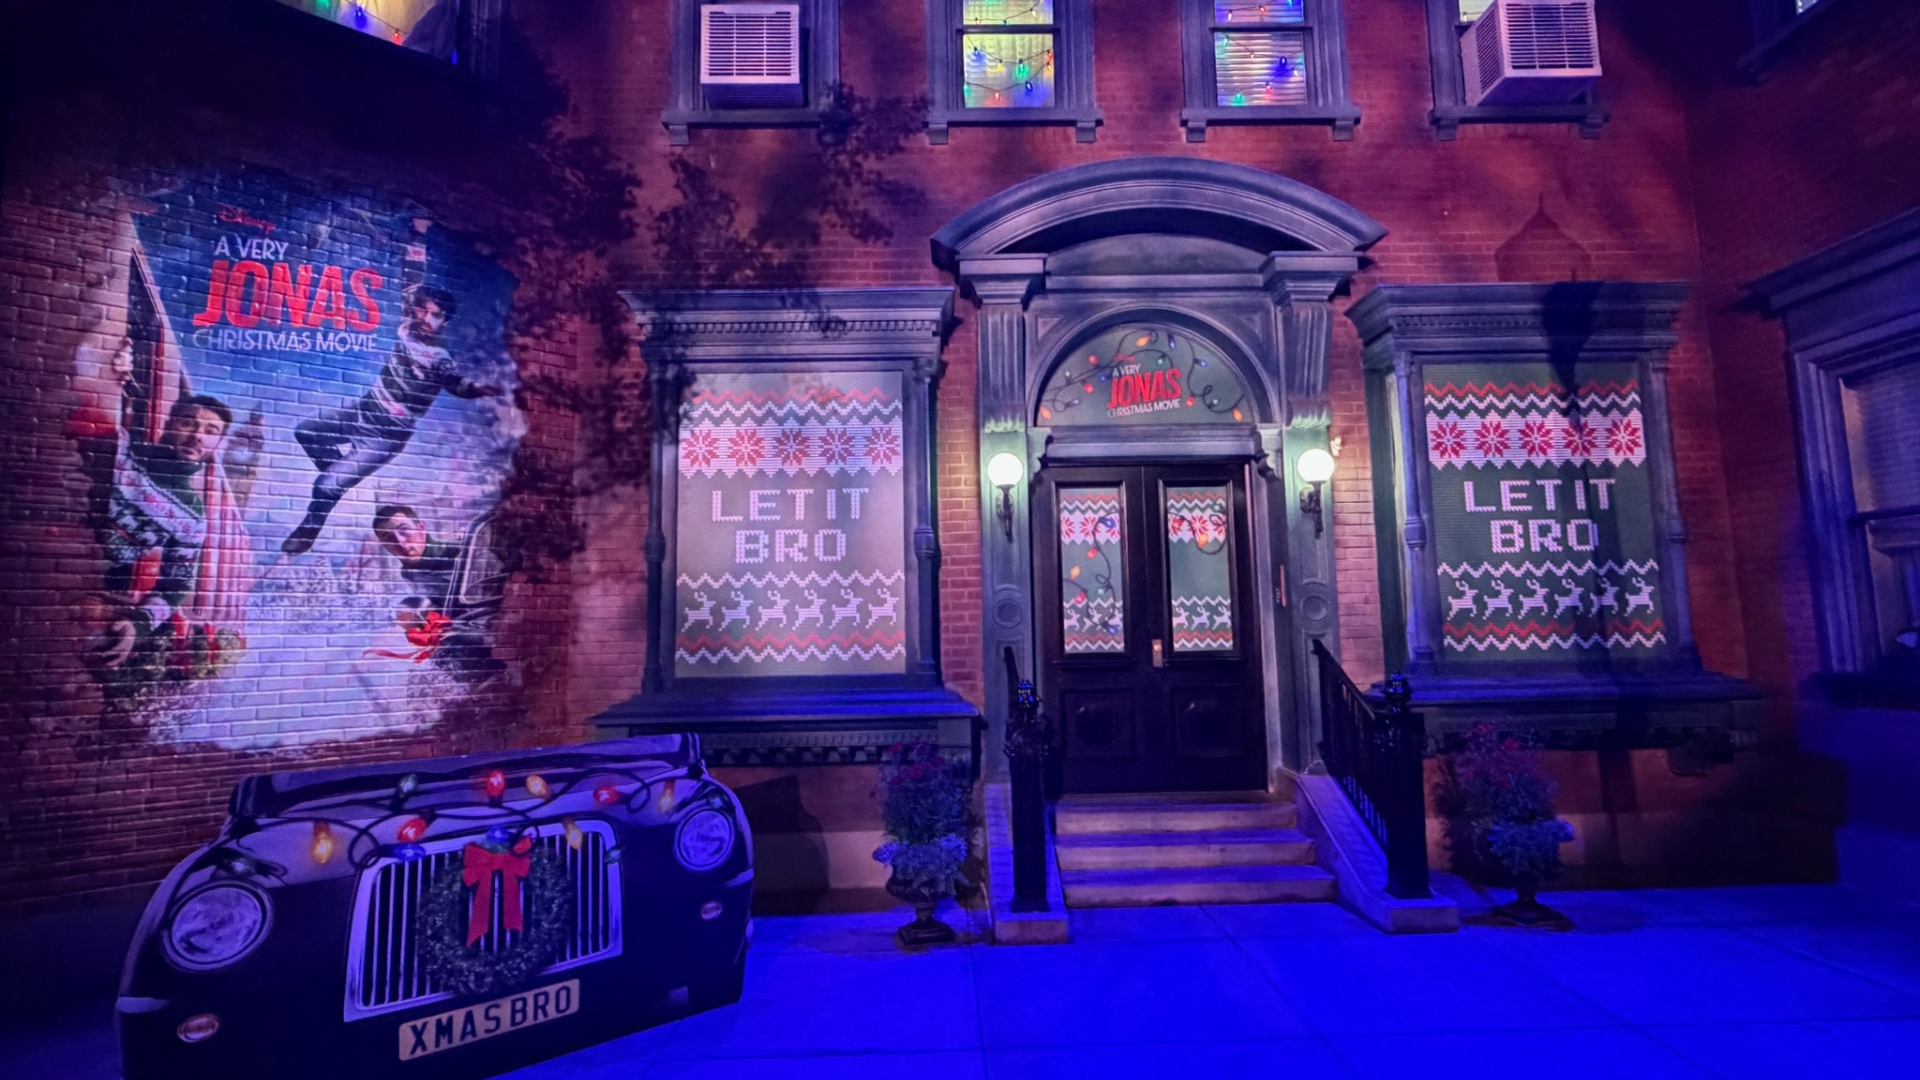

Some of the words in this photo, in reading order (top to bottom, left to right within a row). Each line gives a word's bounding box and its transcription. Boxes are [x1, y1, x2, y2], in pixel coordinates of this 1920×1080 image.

[214, 235, 231, 257] A
[234, 233, 289, 260] VERY
[192, 259, 383, 332] JONAS
[193, 328, 311, 351] CHRISTMAS
[315, 331, 378, 352] MOVIE
[1112, 367, 1120, 377] A
[1120, 364, 1140, 375] VERY
[1107, 368, 1182, 409] JONAS
[1107, 403, 1153, 417] CHRISTMAS
[1153, 398, 1180, 411] MOVIE
[712, 489, 814, 522] LET
[827, 488, 869, 521] IT
[1463, 478, 1562, 512] LET
[1574, 478, 1616, 511] IT
[735, 529, 846, 563] BRO
[1490, 518, 1599, 553] BRO
